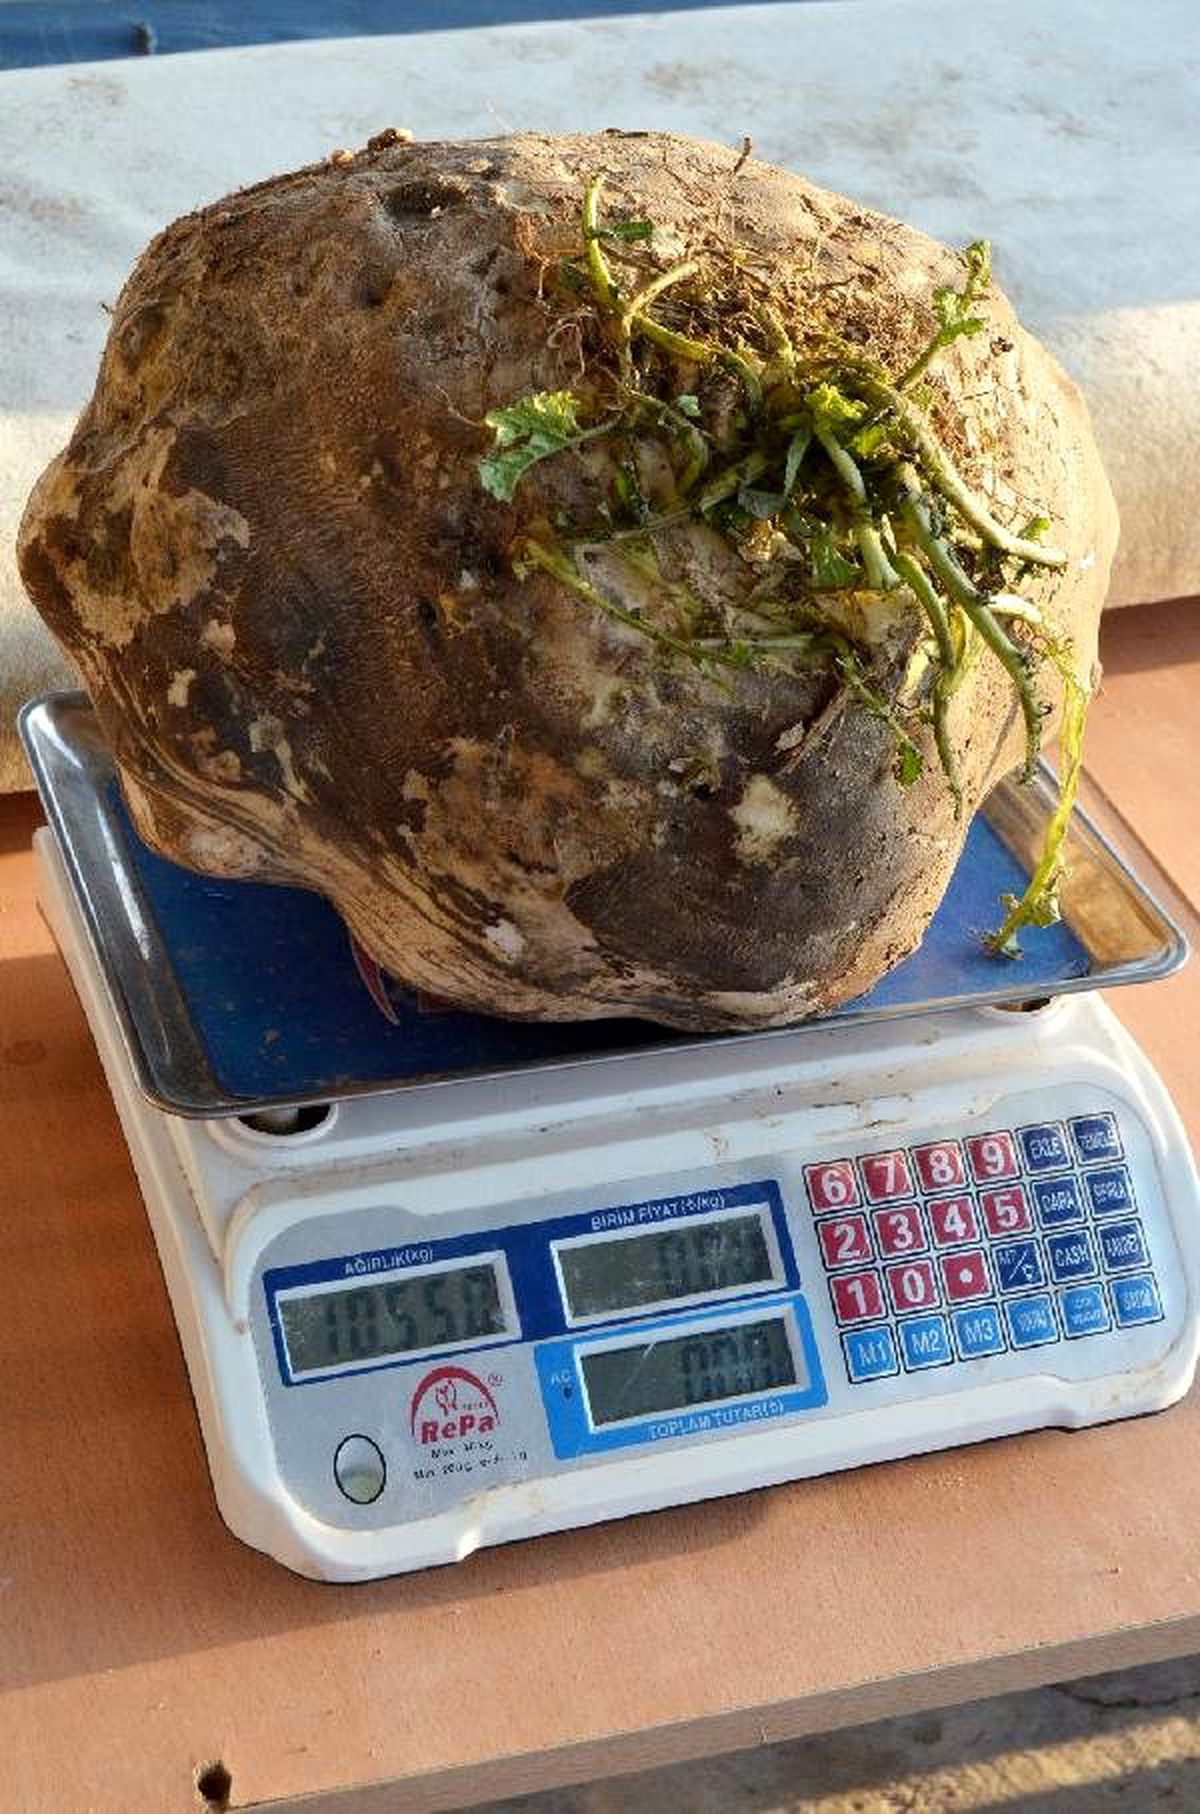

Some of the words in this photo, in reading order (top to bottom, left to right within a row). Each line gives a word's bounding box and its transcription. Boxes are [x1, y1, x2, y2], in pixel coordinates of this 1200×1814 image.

[873, 1157, 895, 1193] 7
[929, 1149, 954, 1184] 8
[983, 1143, 1005, 1175] 9
[821, 1172, 846, 1204] 6
[944, 1205, 966, 1237] 4
[994, 1194, 1019, 1228] 5
[834, 1224, 861, 1259] 2
[890, 1214, 914, 1249] 3
[1055, 1243, 1090, 1267] CASH
[847, 1279, 867, 1314] 1
[902, 1268, 925, 1303] 0
[911, 1329, 941, 1354] M2
[965, 1319, 995, 1344] M3
[858, 1339, 889, 1367] M1
[420, 1414, 495, 1445] RePa
